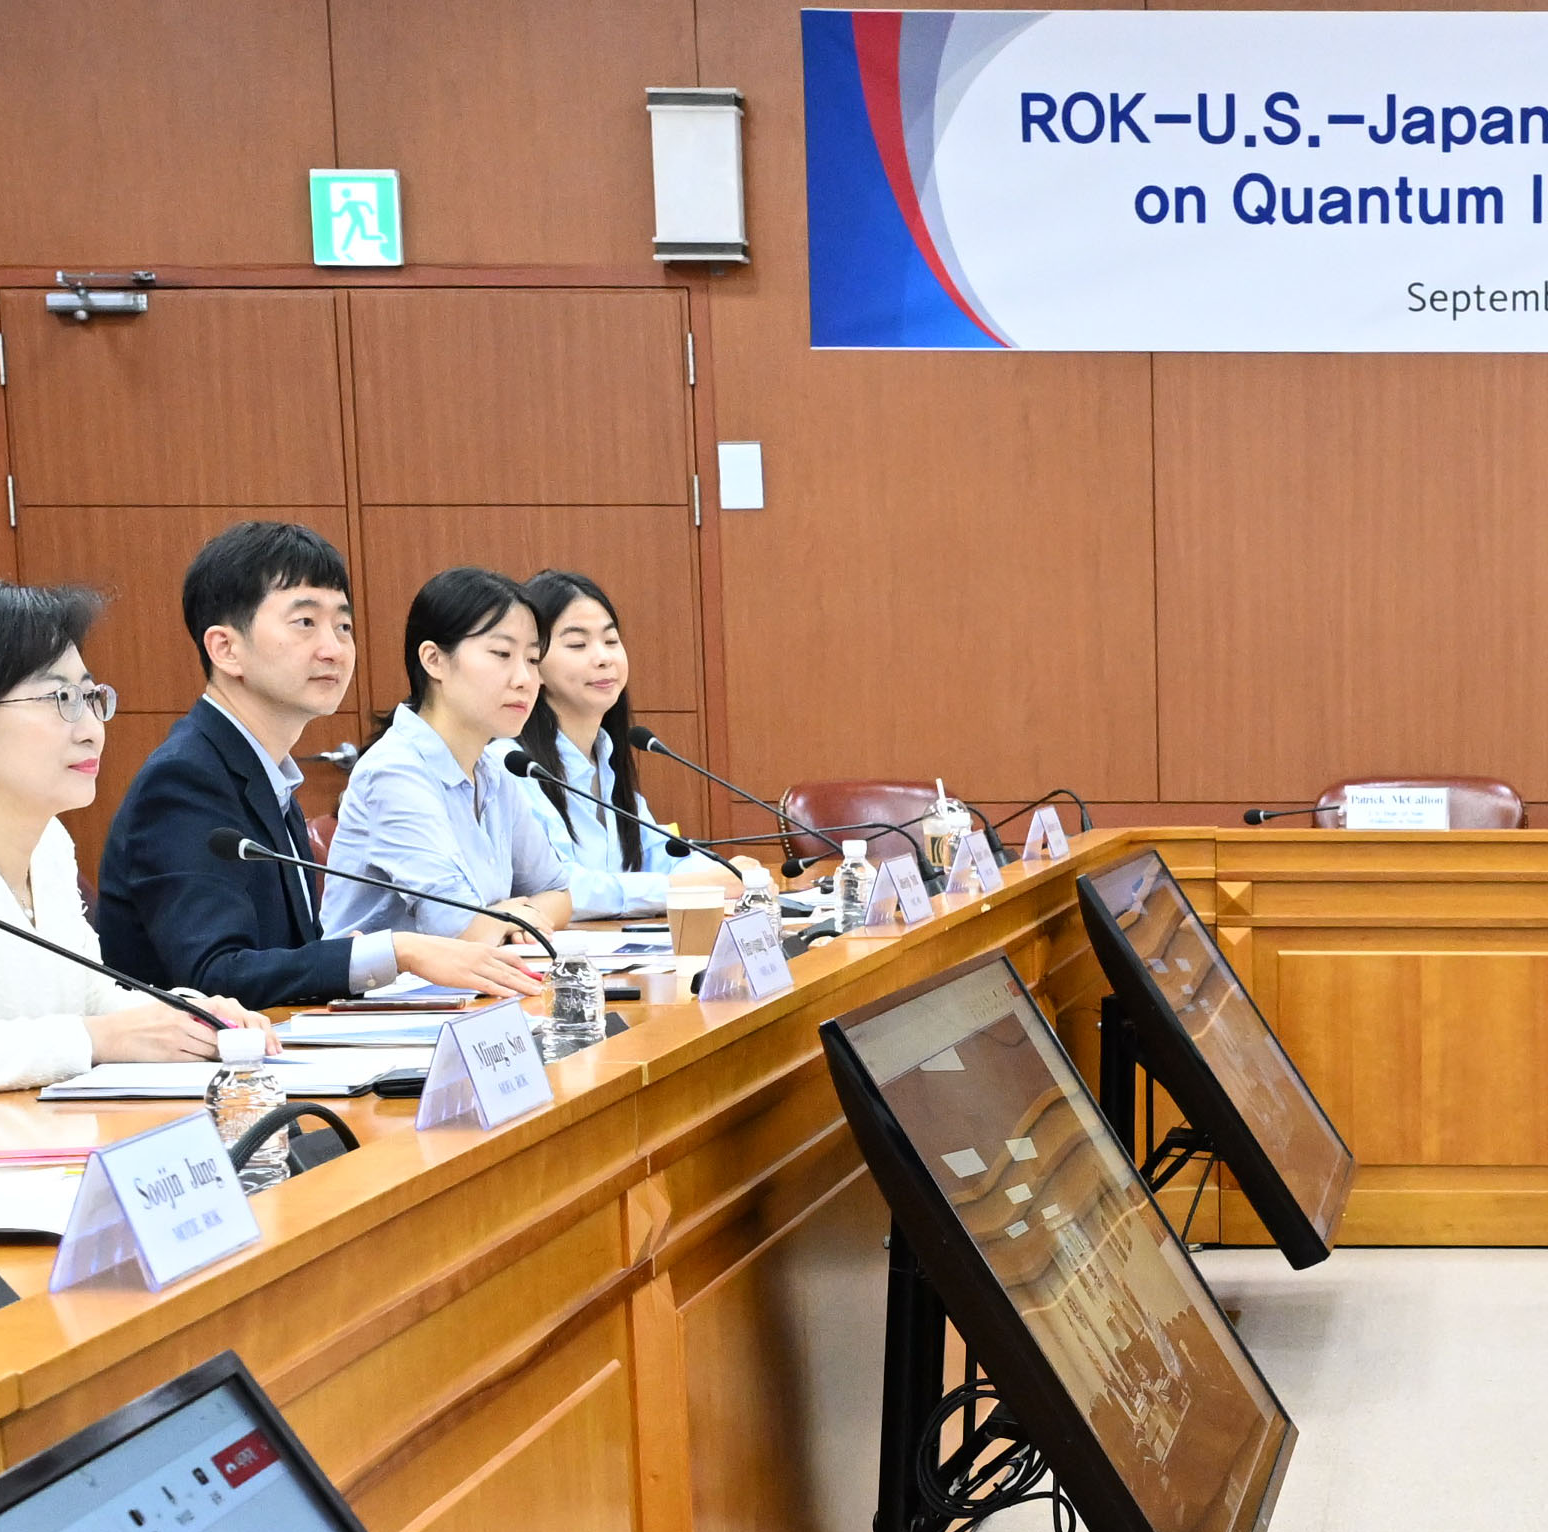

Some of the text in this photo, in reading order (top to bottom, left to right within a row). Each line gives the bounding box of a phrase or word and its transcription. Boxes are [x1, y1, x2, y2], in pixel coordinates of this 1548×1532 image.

[1134, 185, 1206, 225] on
[1232, 172, 1504, 225] Quantum
[472, 1031, 526, 1073] Mijung Son
[134, 1158, 225, 1211] Soojin Jung
